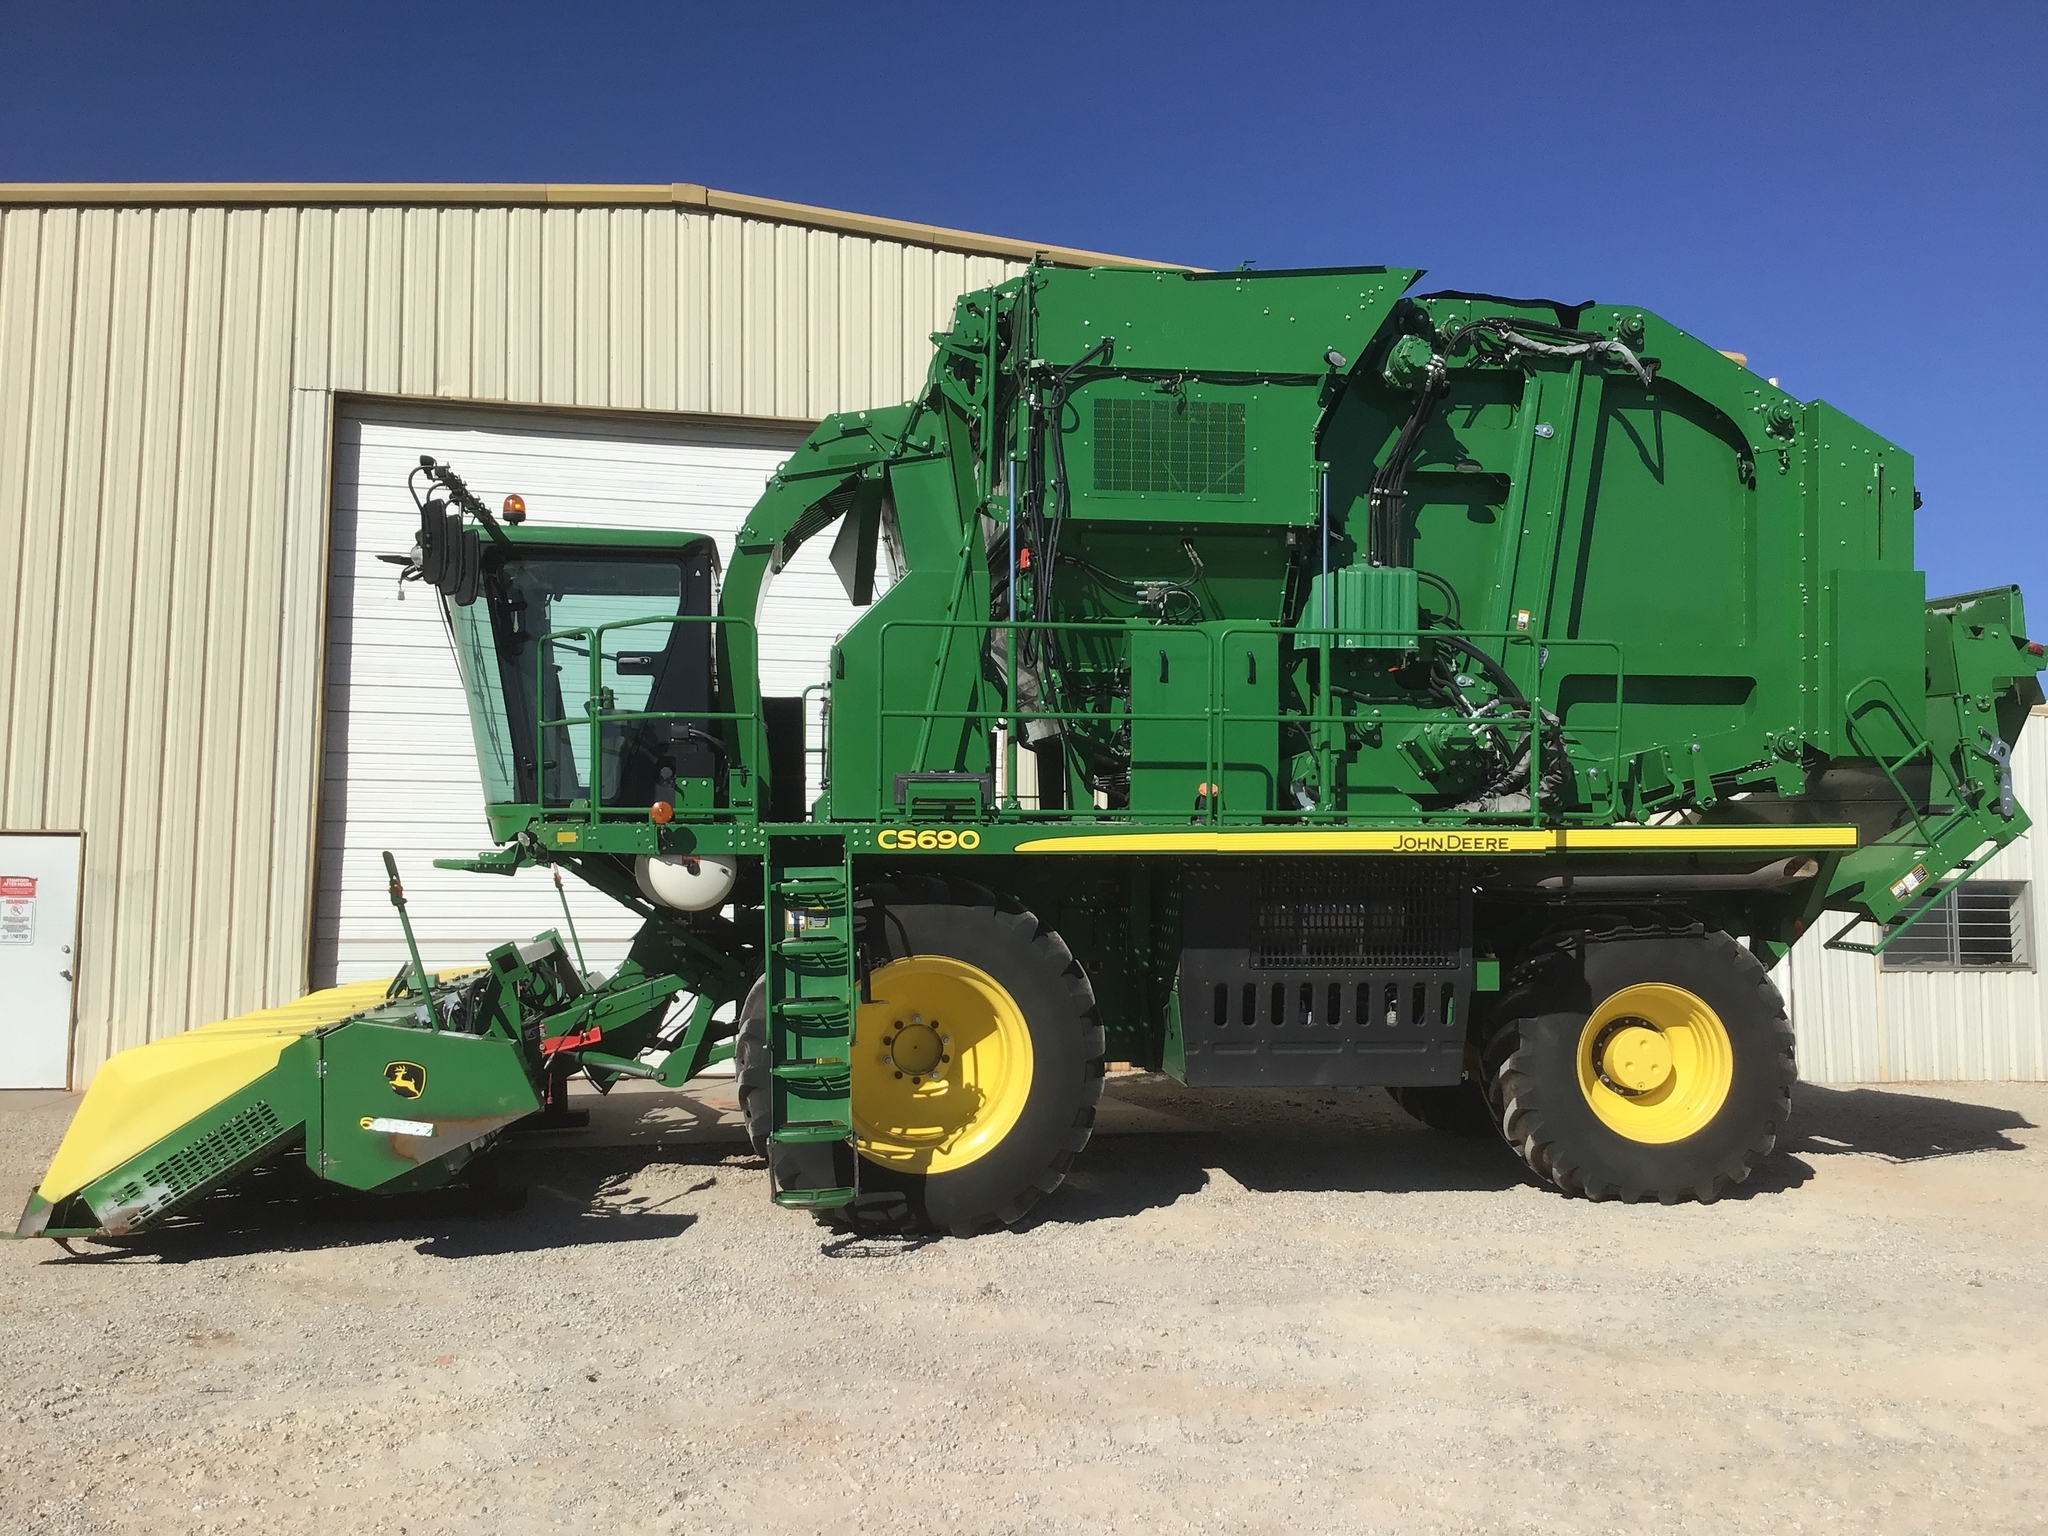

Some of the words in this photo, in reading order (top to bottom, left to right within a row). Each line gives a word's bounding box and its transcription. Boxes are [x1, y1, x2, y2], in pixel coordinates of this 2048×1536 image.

[877, 829, 981, 850] CS690
[1393, 834, 1443, 850] JOHN
[1447, 834, 1510, 850] DEERE
